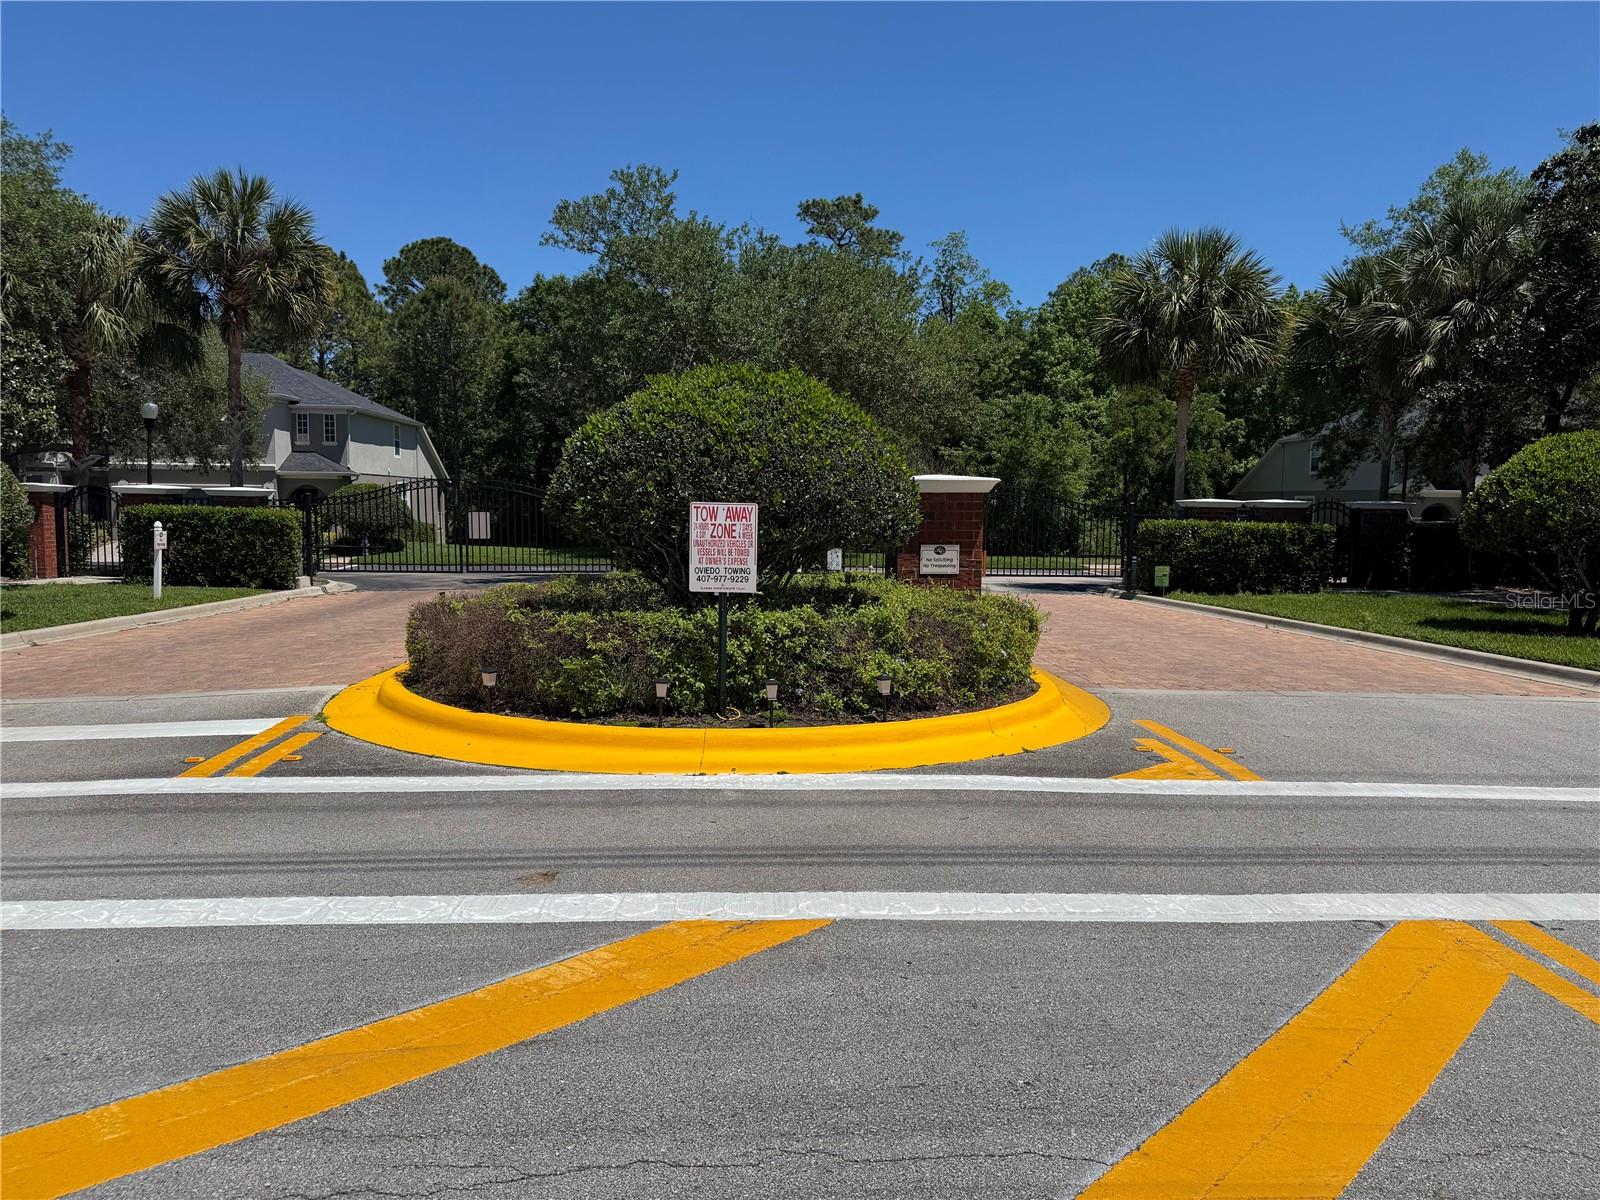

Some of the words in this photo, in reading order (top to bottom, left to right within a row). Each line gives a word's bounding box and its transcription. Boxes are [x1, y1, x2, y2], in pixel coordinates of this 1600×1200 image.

[693, 506, 719, 522] TOW
[725, 506, 754, 523] AWAY
[710, 523, 737, 539] ZONE
[742, 523, 753, 532] DAYS
[738, 531, 742, 540] A
[742, 531, 754, 540] WEEK
[693, 540, 726, 548] UNAUTHORIZED
[727, 540, 747, 549] VEHICLES
[747, 540, 754, 549] OR
[697, 548, 716, 557] VESSELS
[717, 548, 727, 557] WILL
[728, 548, 734, 557] BE
[734, 548, 750, 558] TOWED
[698, 557, 704, 565] AT
[705, 557, 727, 566] OWNER'S
[728, 557, 749, 566] EXPENSE
[694, 567, 720, 575] OVIEDO
[723, 567, 751, 575] TOWING
[696, 575, 750, 583] 407-977-9229
